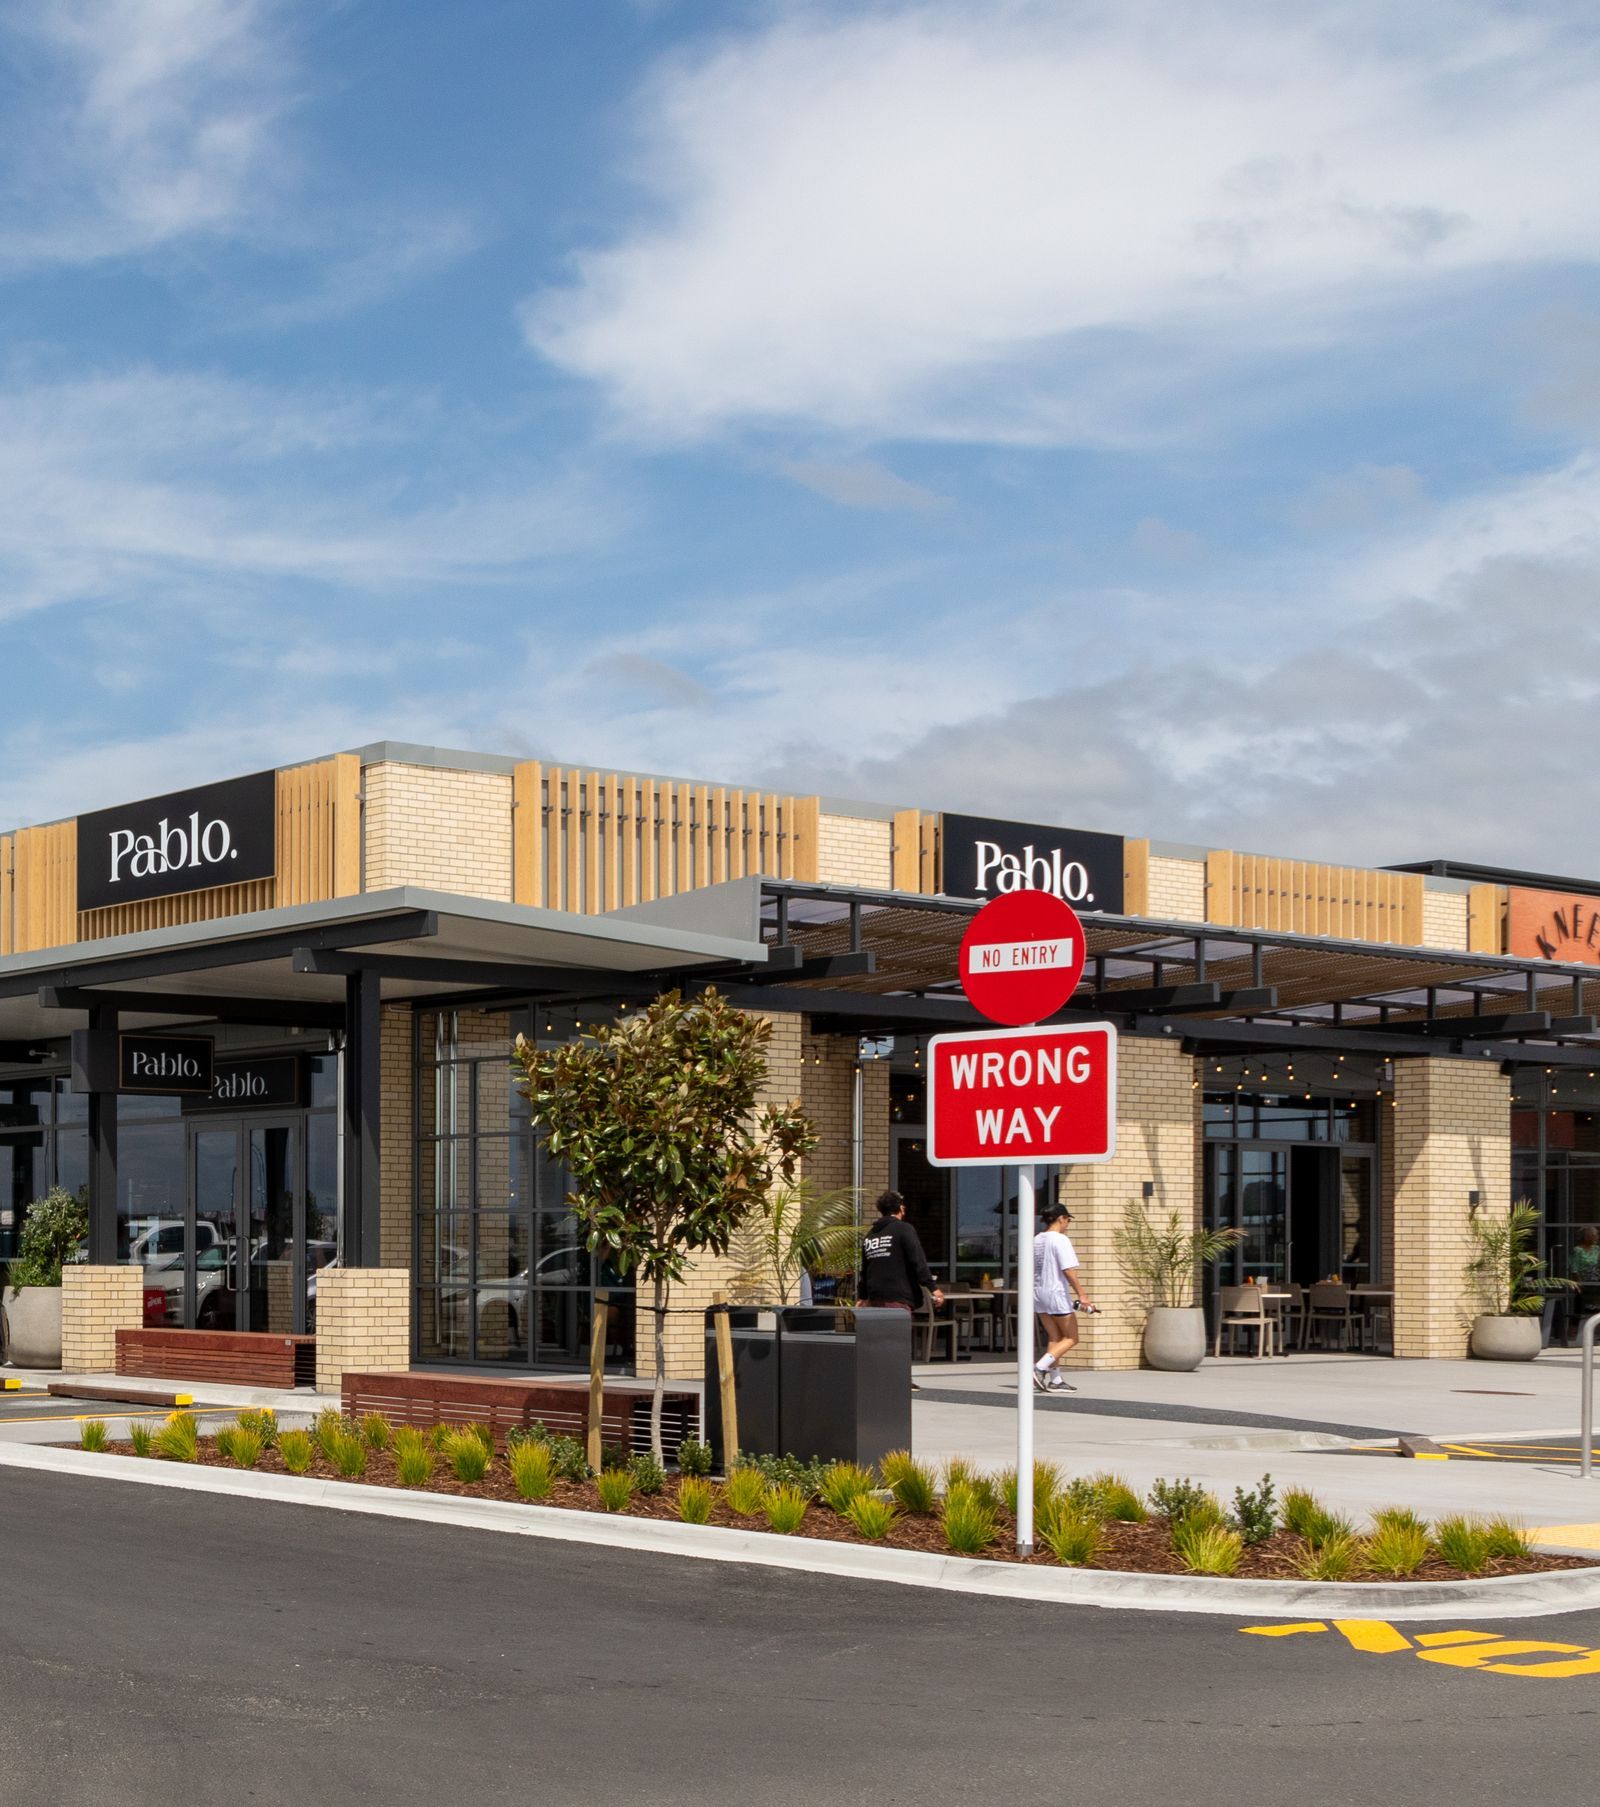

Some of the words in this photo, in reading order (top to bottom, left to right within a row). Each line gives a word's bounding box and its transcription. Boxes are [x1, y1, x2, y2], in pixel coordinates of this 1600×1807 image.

[108, 811, 238, 882] Pablo.
[974, 840, 1095, 903] Pablo.
[982, 950, 1001, 968] NO
[1012, 945, 1059, 967] ENTRY
[132, 1051, 202, 1078] Pablo.
[950, 1046, 1091, 1090] WRONG
[975, 1106, 1062, 1145] WAY
